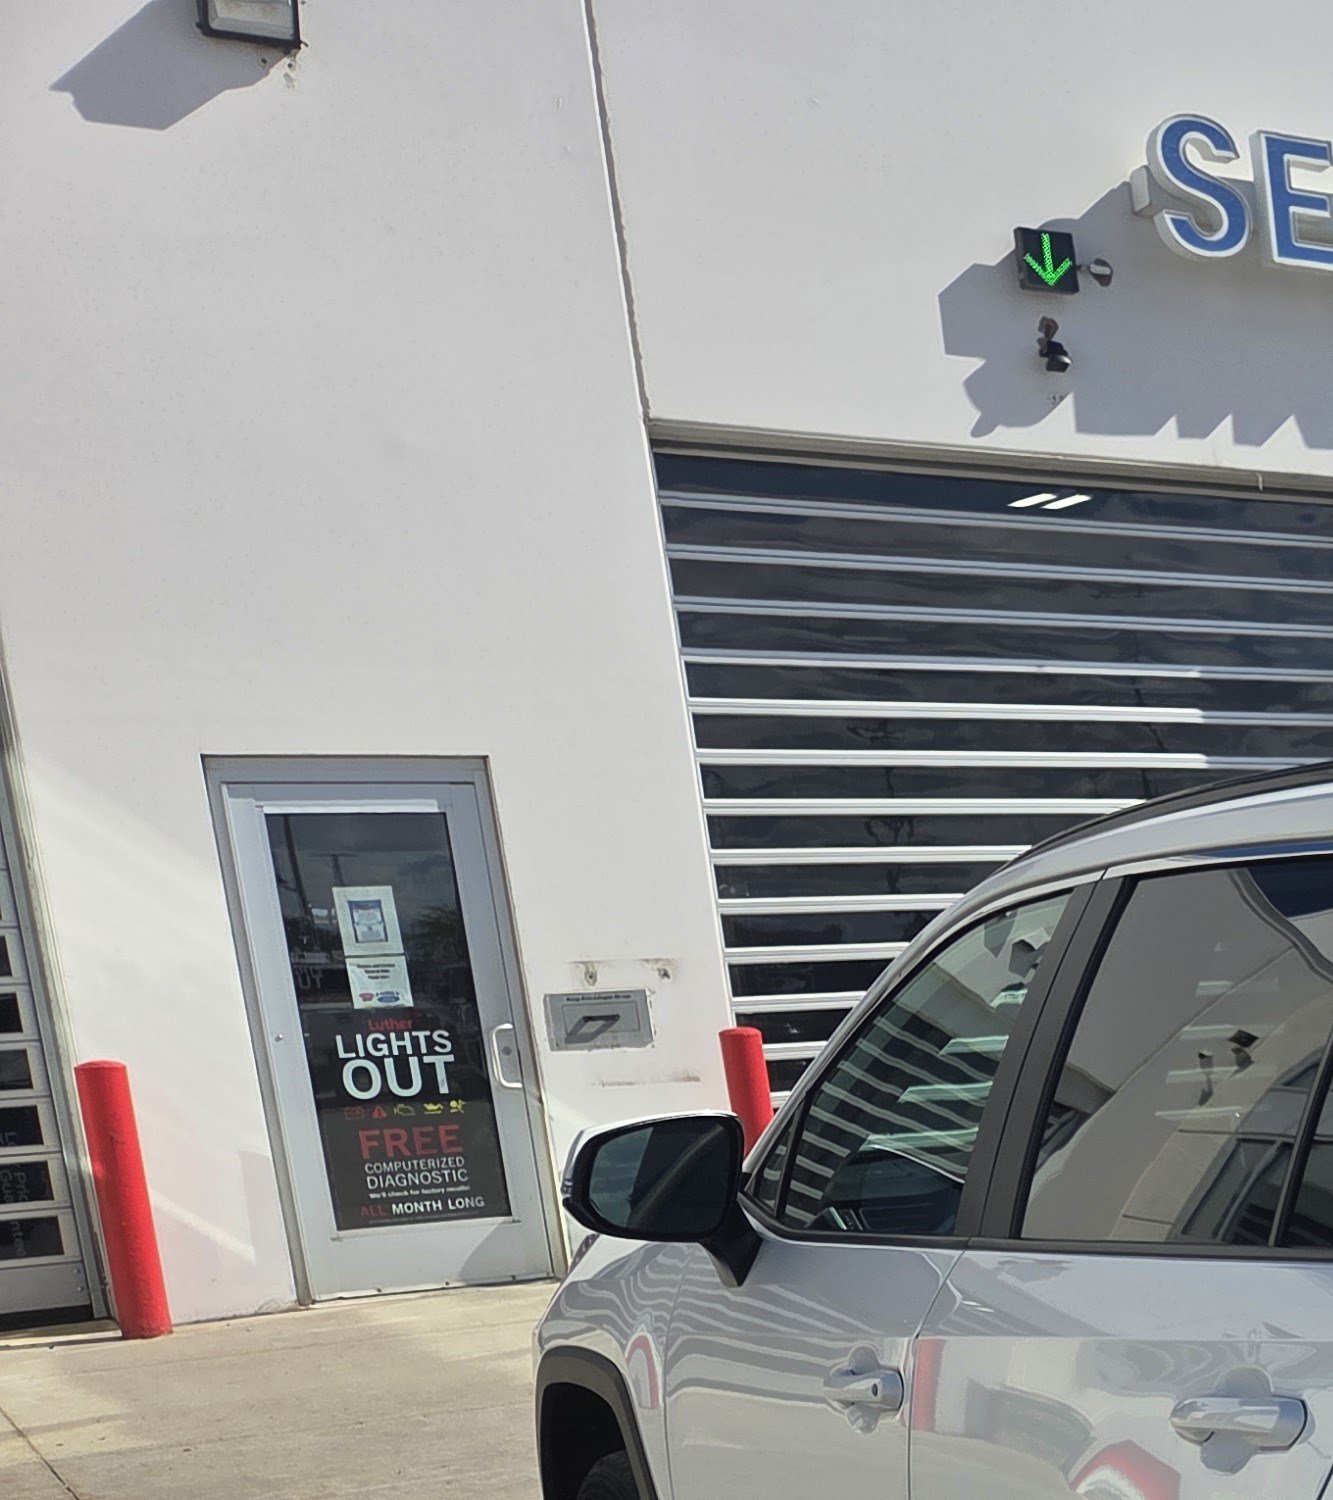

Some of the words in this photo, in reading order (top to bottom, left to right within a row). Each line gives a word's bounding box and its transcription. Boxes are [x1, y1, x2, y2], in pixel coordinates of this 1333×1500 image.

[367, 1018, 413, 1031] Luther
[335, 1029, 452, 1059] LIGHTS
[342, 1054, 455, 1100] OUT
[358, 1124, 464, 1160] FREE
[364, 1156, 465, 1174] COMPUTERIZED
[366, 1168, 469, 1190] DIAGNOSTIC
[360, 1204, 388, 1218] ALL
[391, 1199, 442, 1215] MONTH
[447, 1196, 485, 1211] LONG
